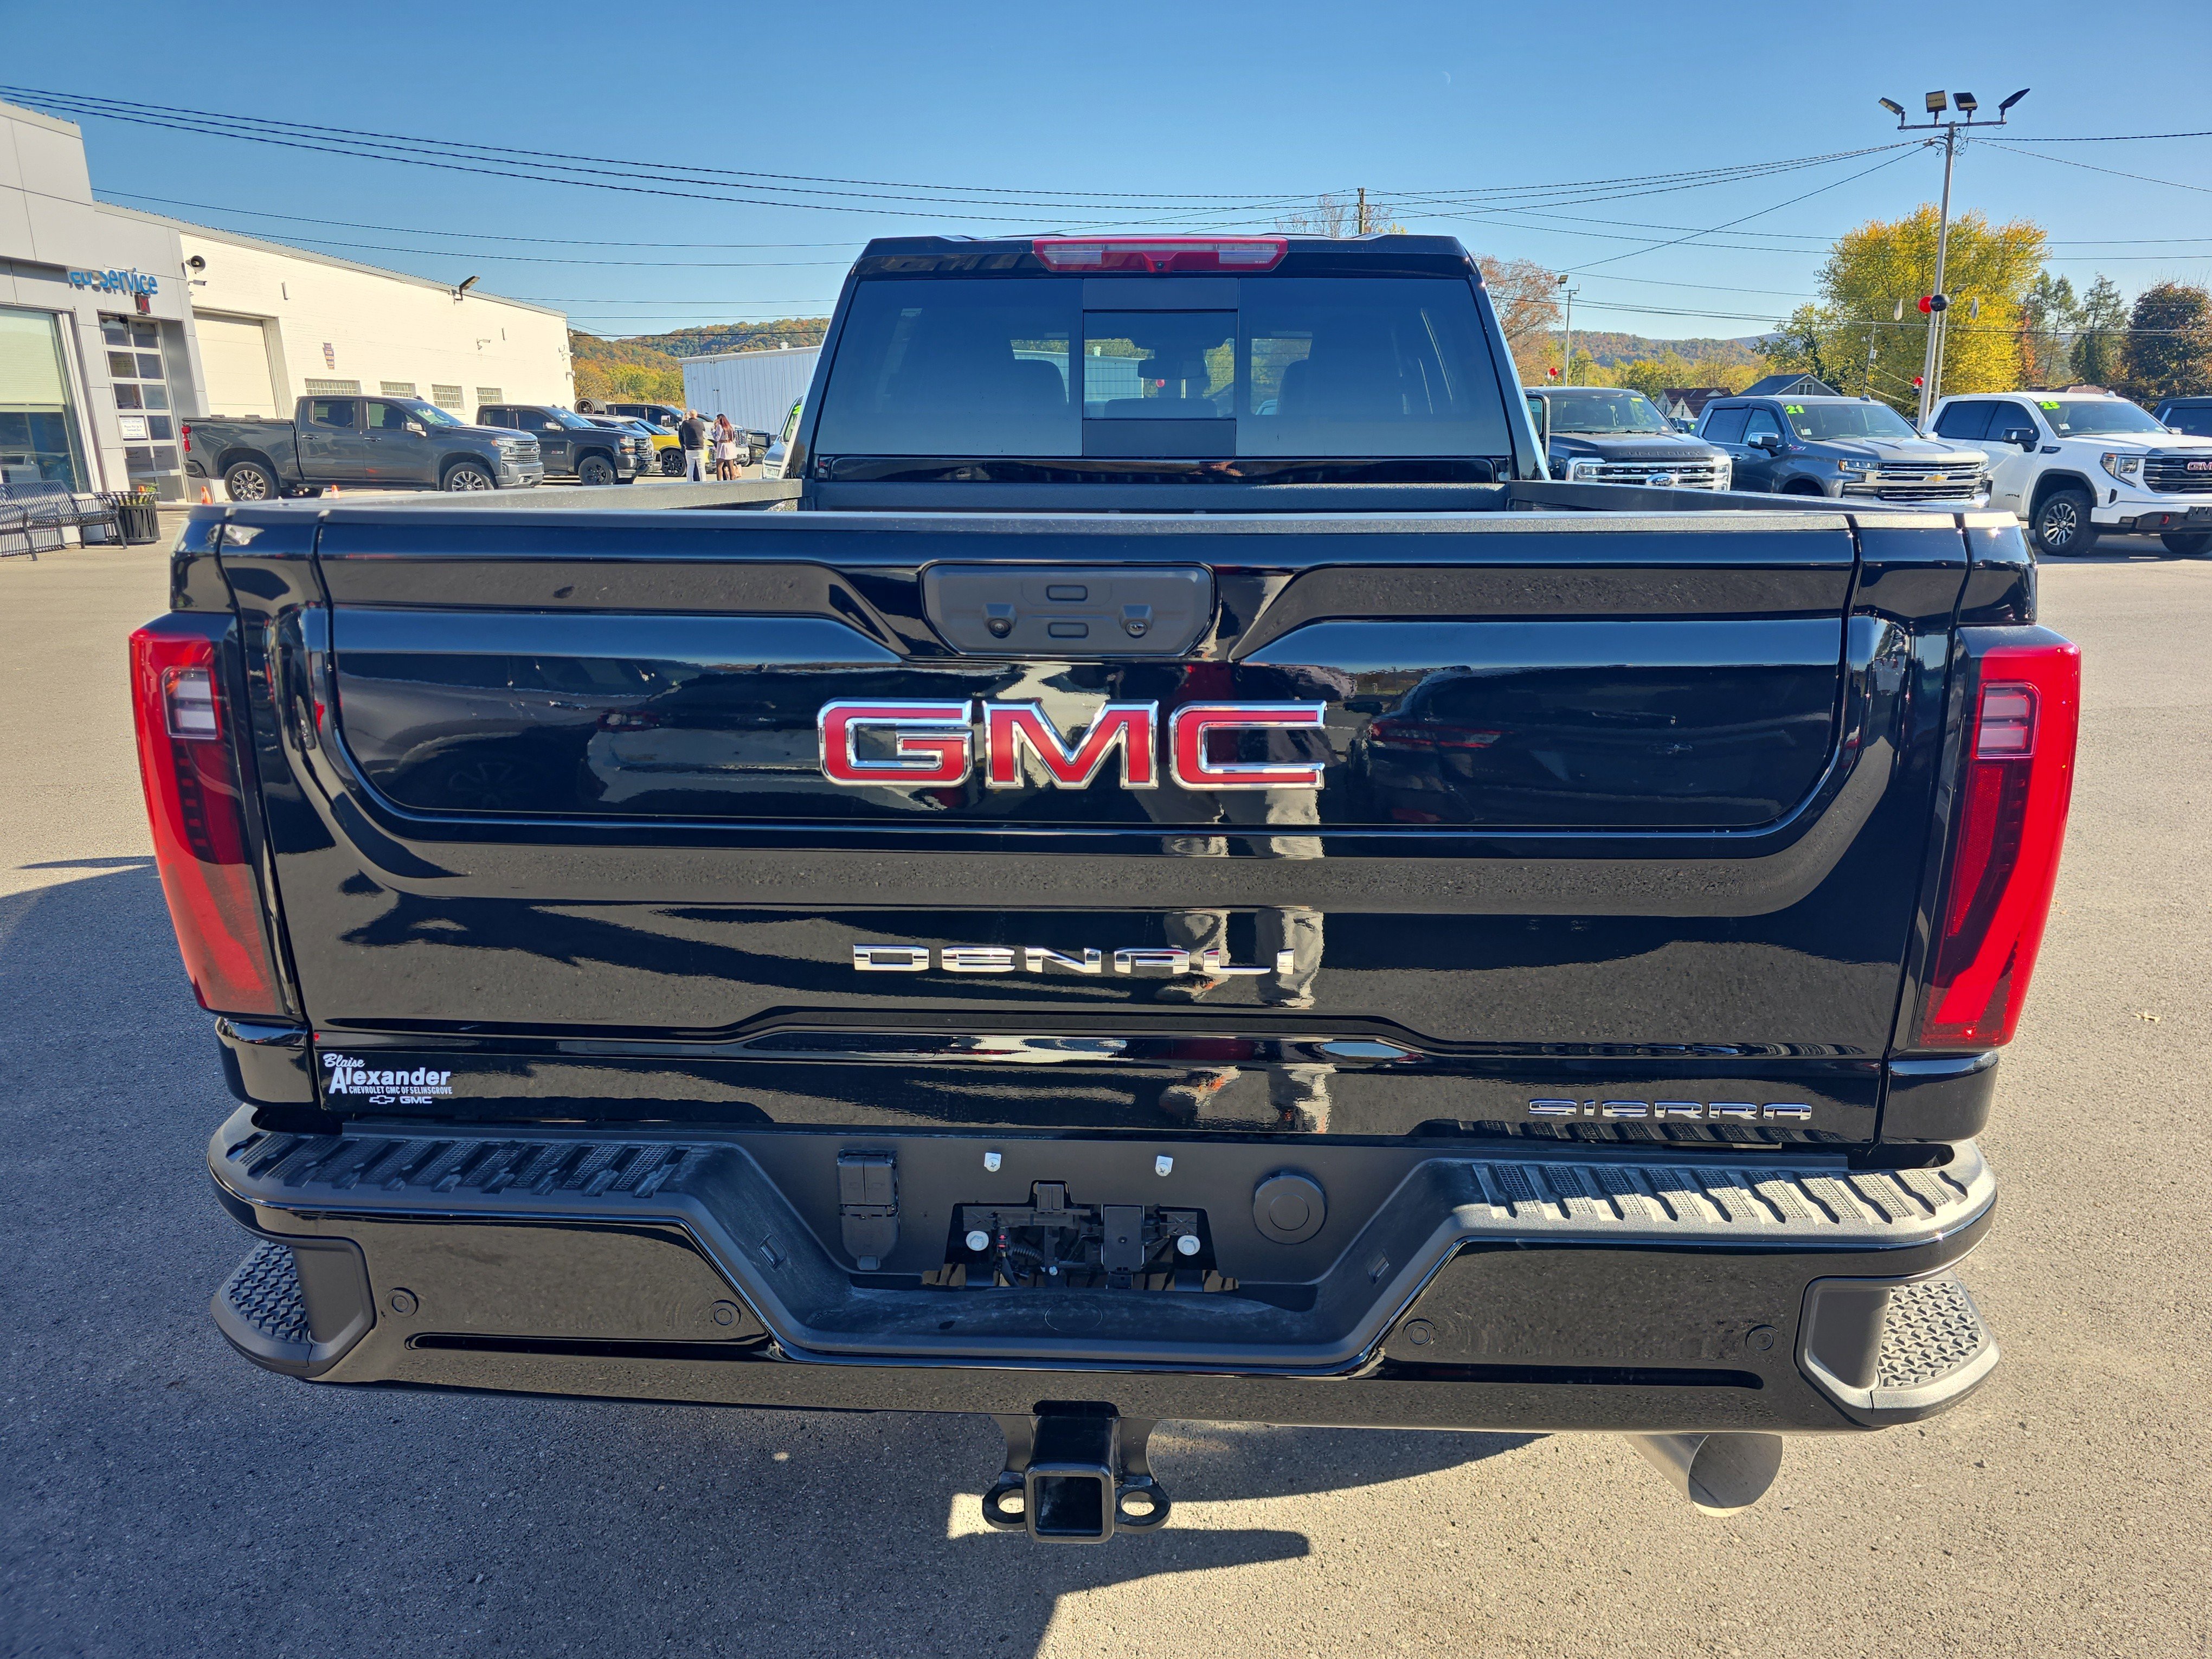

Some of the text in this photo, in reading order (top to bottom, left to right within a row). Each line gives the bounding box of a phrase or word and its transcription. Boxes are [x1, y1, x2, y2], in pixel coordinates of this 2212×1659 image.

[1785, 405, 1805, 414] 21
[2040, 401, 2060, 410] 23
[2187, 461, 2212, 471] GM
[816, 697, 1327, 790] GMC
[853, 943, 1295, 975] DENALI
[323, 1053, 365, 1068] Blaise
[329, 1067, 451, 1094] Alexander
[349, 1086, 384, 1094] CHEVROLET
[409, 1086, 452, 1095] SELINSGROVE
[400, 1096, 433, 1104] GMC
[1528, 1098, 1812, 1121] SIERRA
